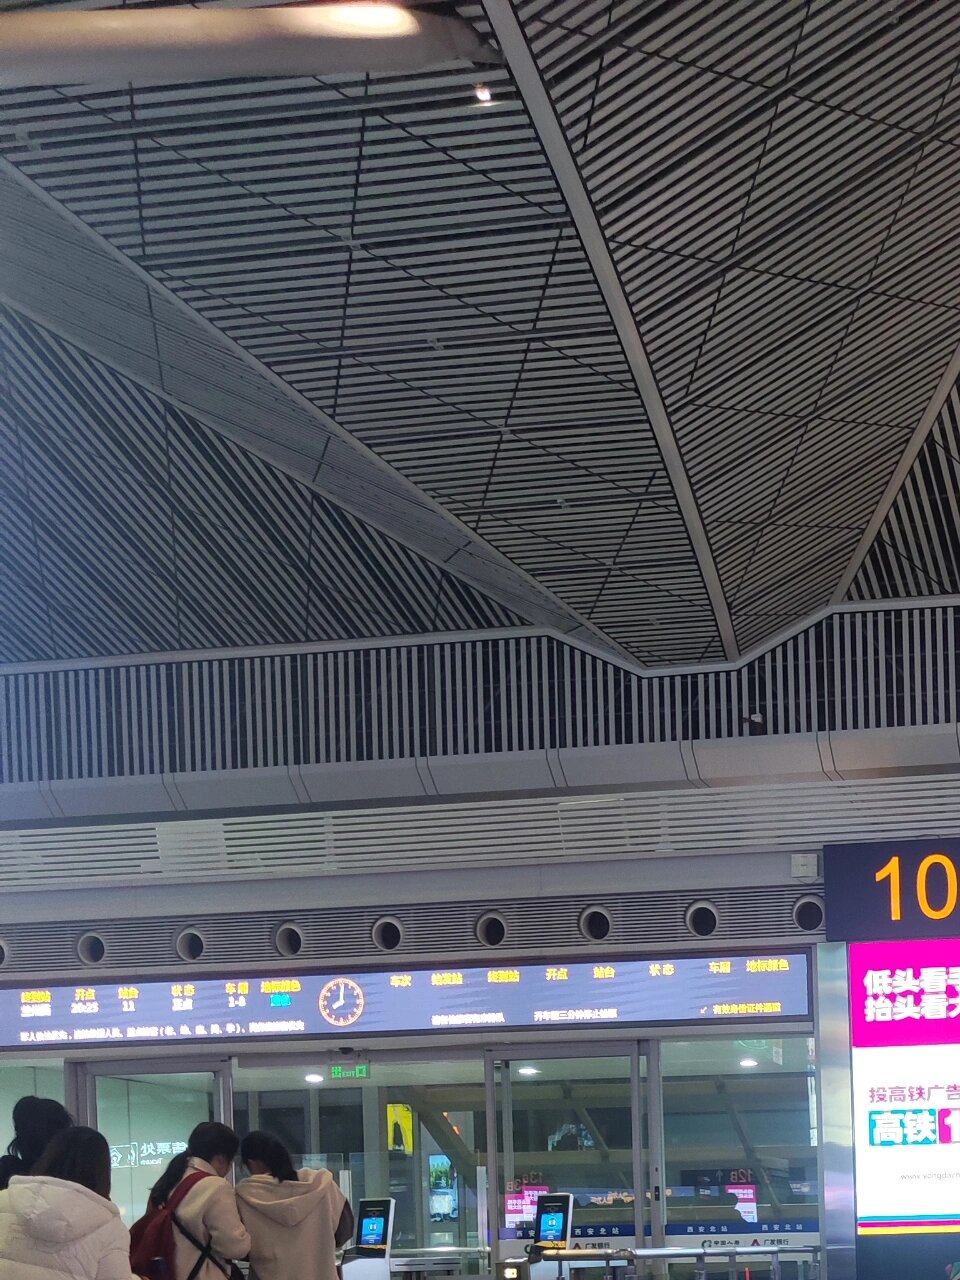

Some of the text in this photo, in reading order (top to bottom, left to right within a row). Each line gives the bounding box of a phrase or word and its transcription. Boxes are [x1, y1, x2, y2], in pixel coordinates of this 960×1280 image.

[687, 1225, 728, 1233] 西安北站
[762, 1223, 803, 1231] 西安北站
[574, 1227, 620, 1236] 西安北站
